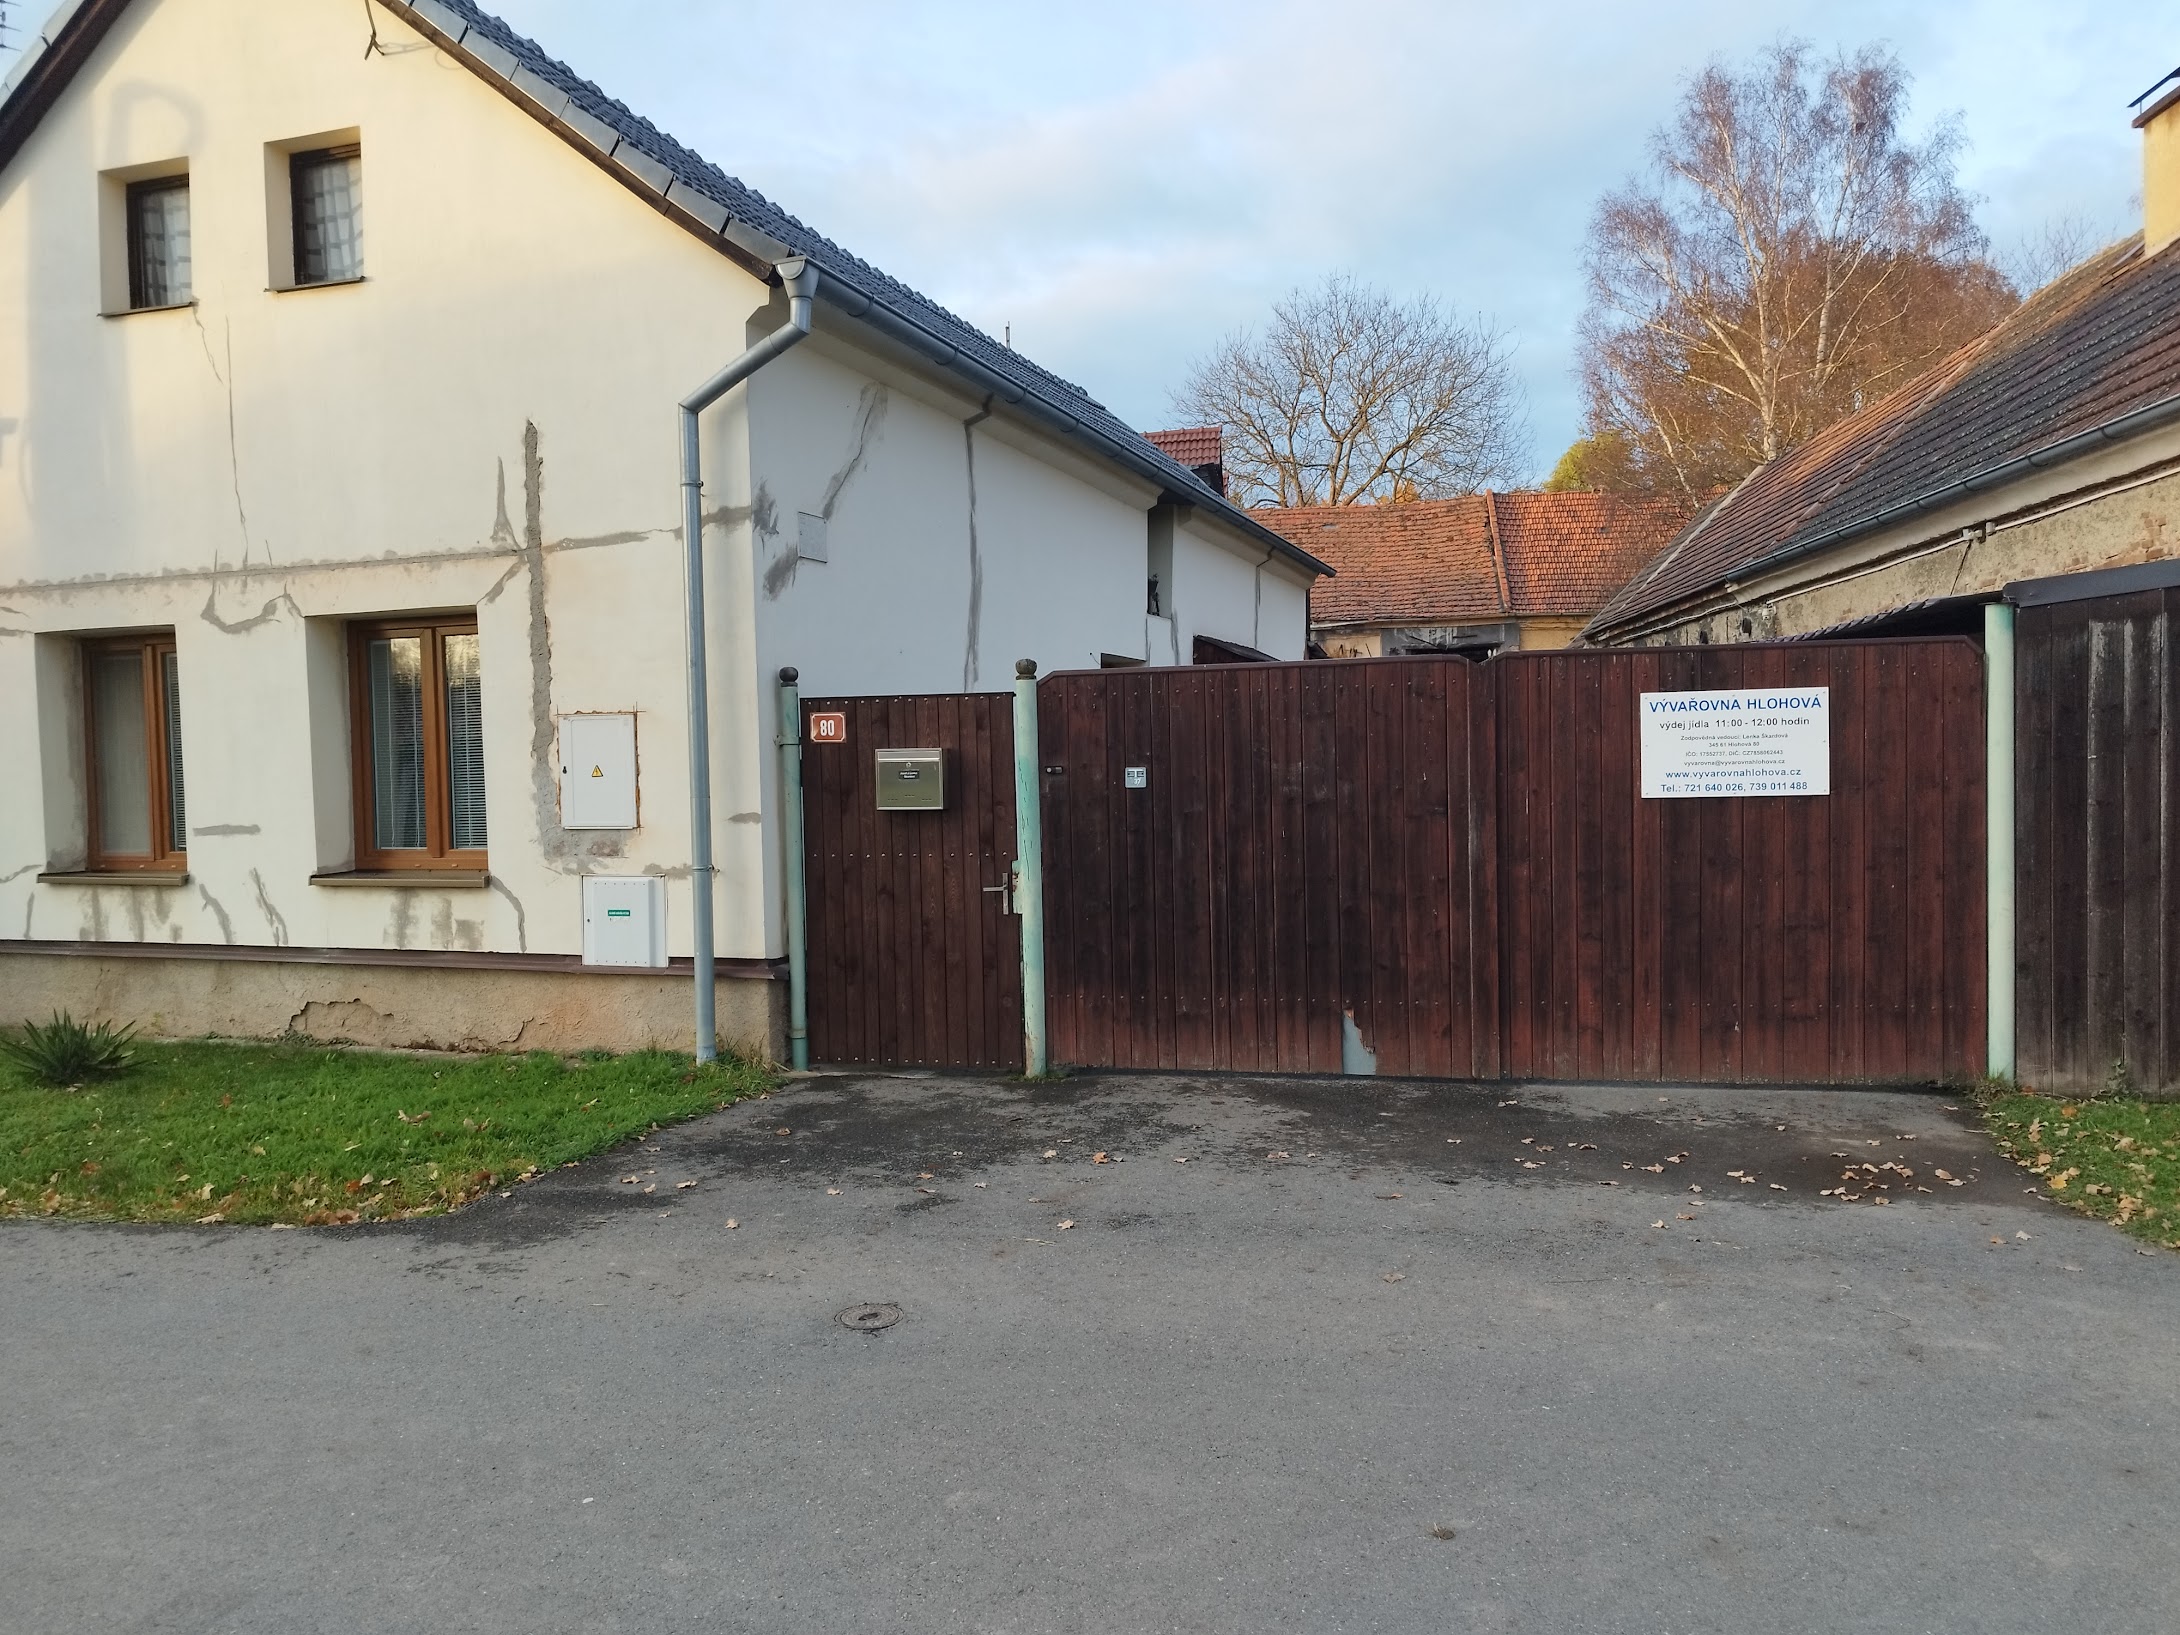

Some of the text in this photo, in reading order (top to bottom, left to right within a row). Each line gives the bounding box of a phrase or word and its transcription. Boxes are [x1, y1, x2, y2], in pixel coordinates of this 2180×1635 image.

[1650, 694, 1822, 712] VÝVAŘOVNA HLOHOVÁ
[820, 719, 835, 736] 80
[1660, 720, 1686, 730] výdej
[1688, 720, 1709, 730] jídla
[1716, 719, 1742, 728] 11:00
[1752, 718, 1778, 726] 12:00
[1781, 717, 1809, 726] hodin
[1666, 768, 1801, 779] www.vyvarovnahlohova.cz
[1660, 782, 1808, 792] Tel.: 721 640 026, 739 011 488
